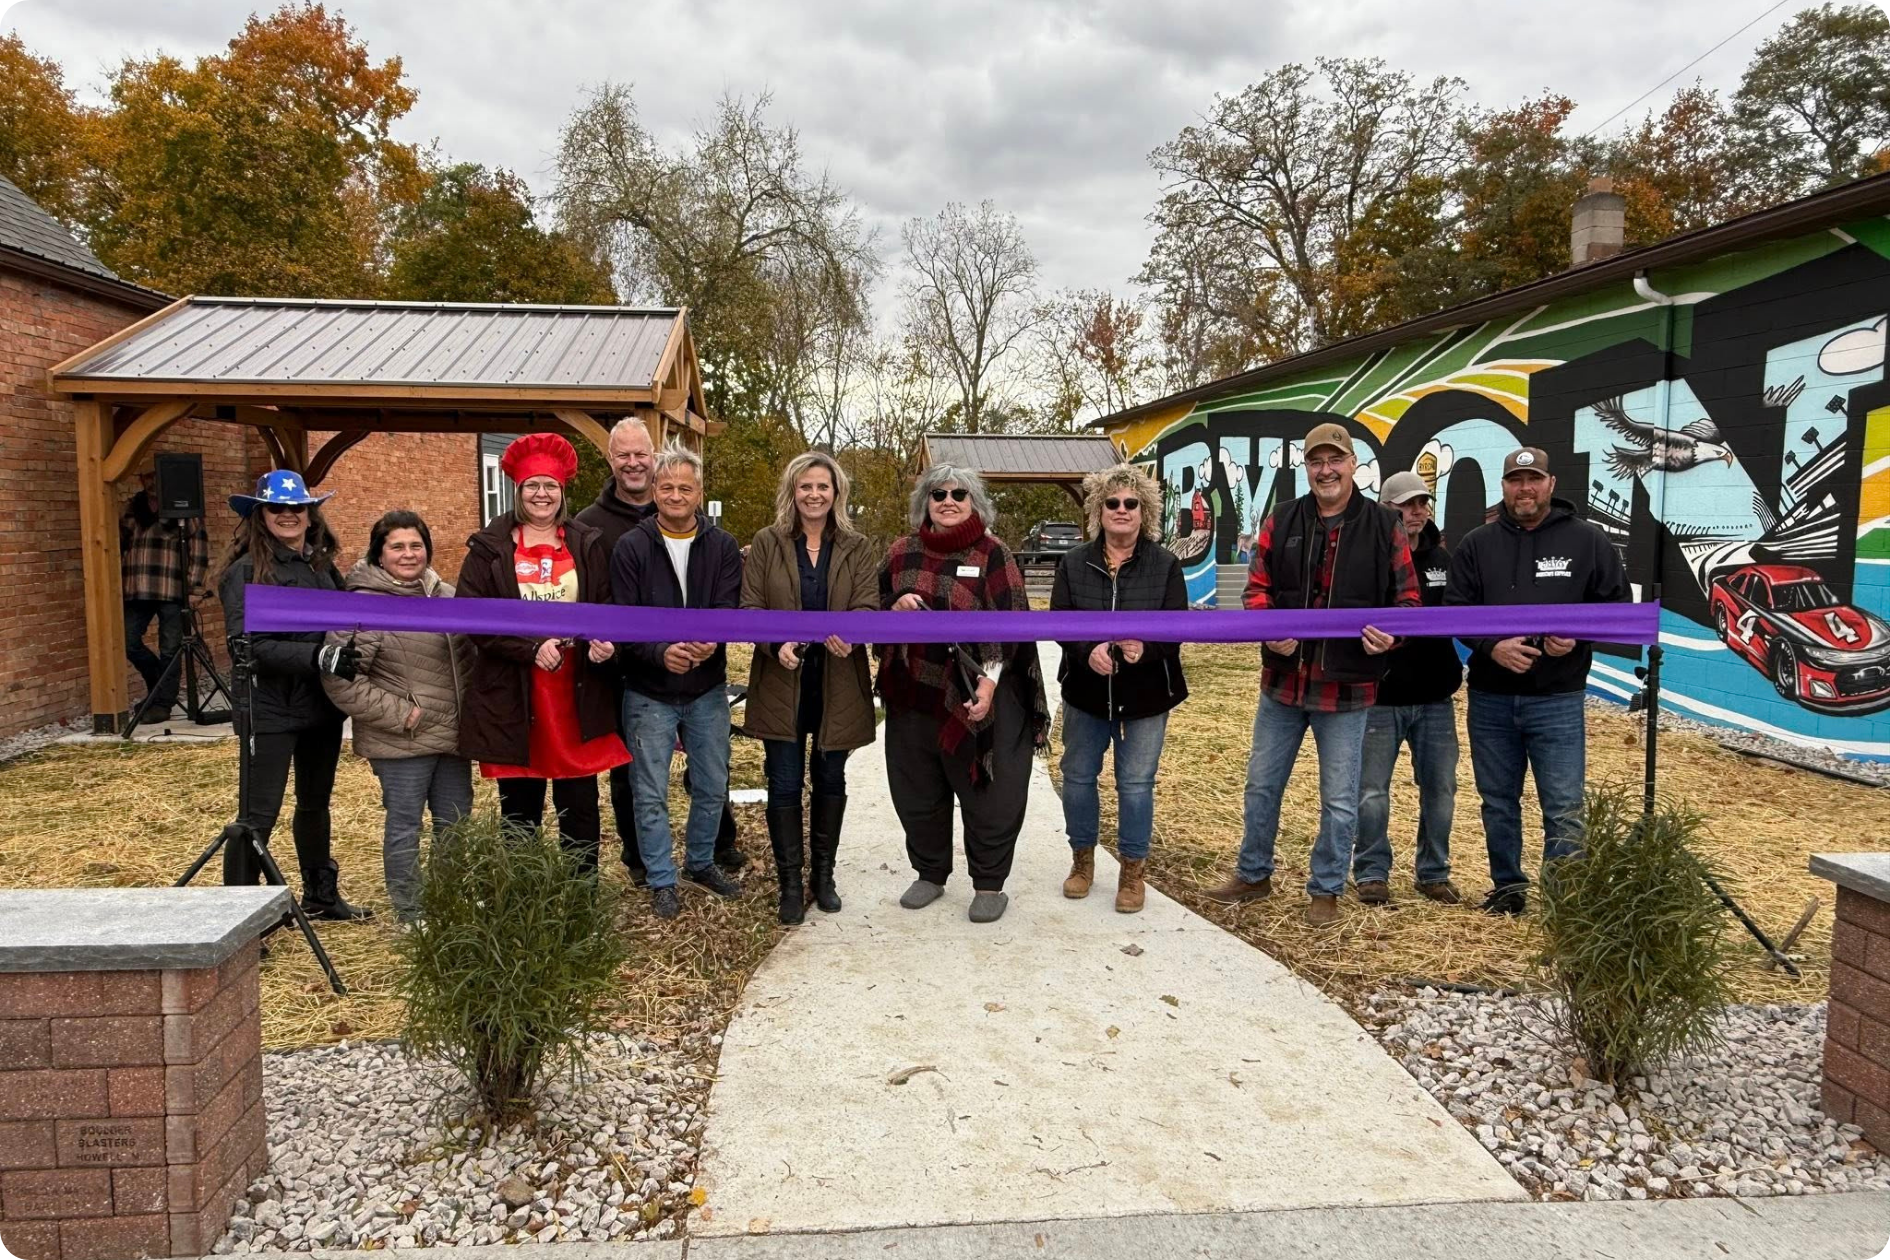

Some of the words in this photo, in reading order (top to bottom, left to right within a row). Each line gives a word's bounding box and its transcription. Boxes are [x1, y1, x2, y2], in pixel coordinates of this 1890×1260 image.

[1736, 609, 1760, 645] 4
[1824, 612, 1860, 643] 4
[78, 1138, 136, 1148] BLASTERS
